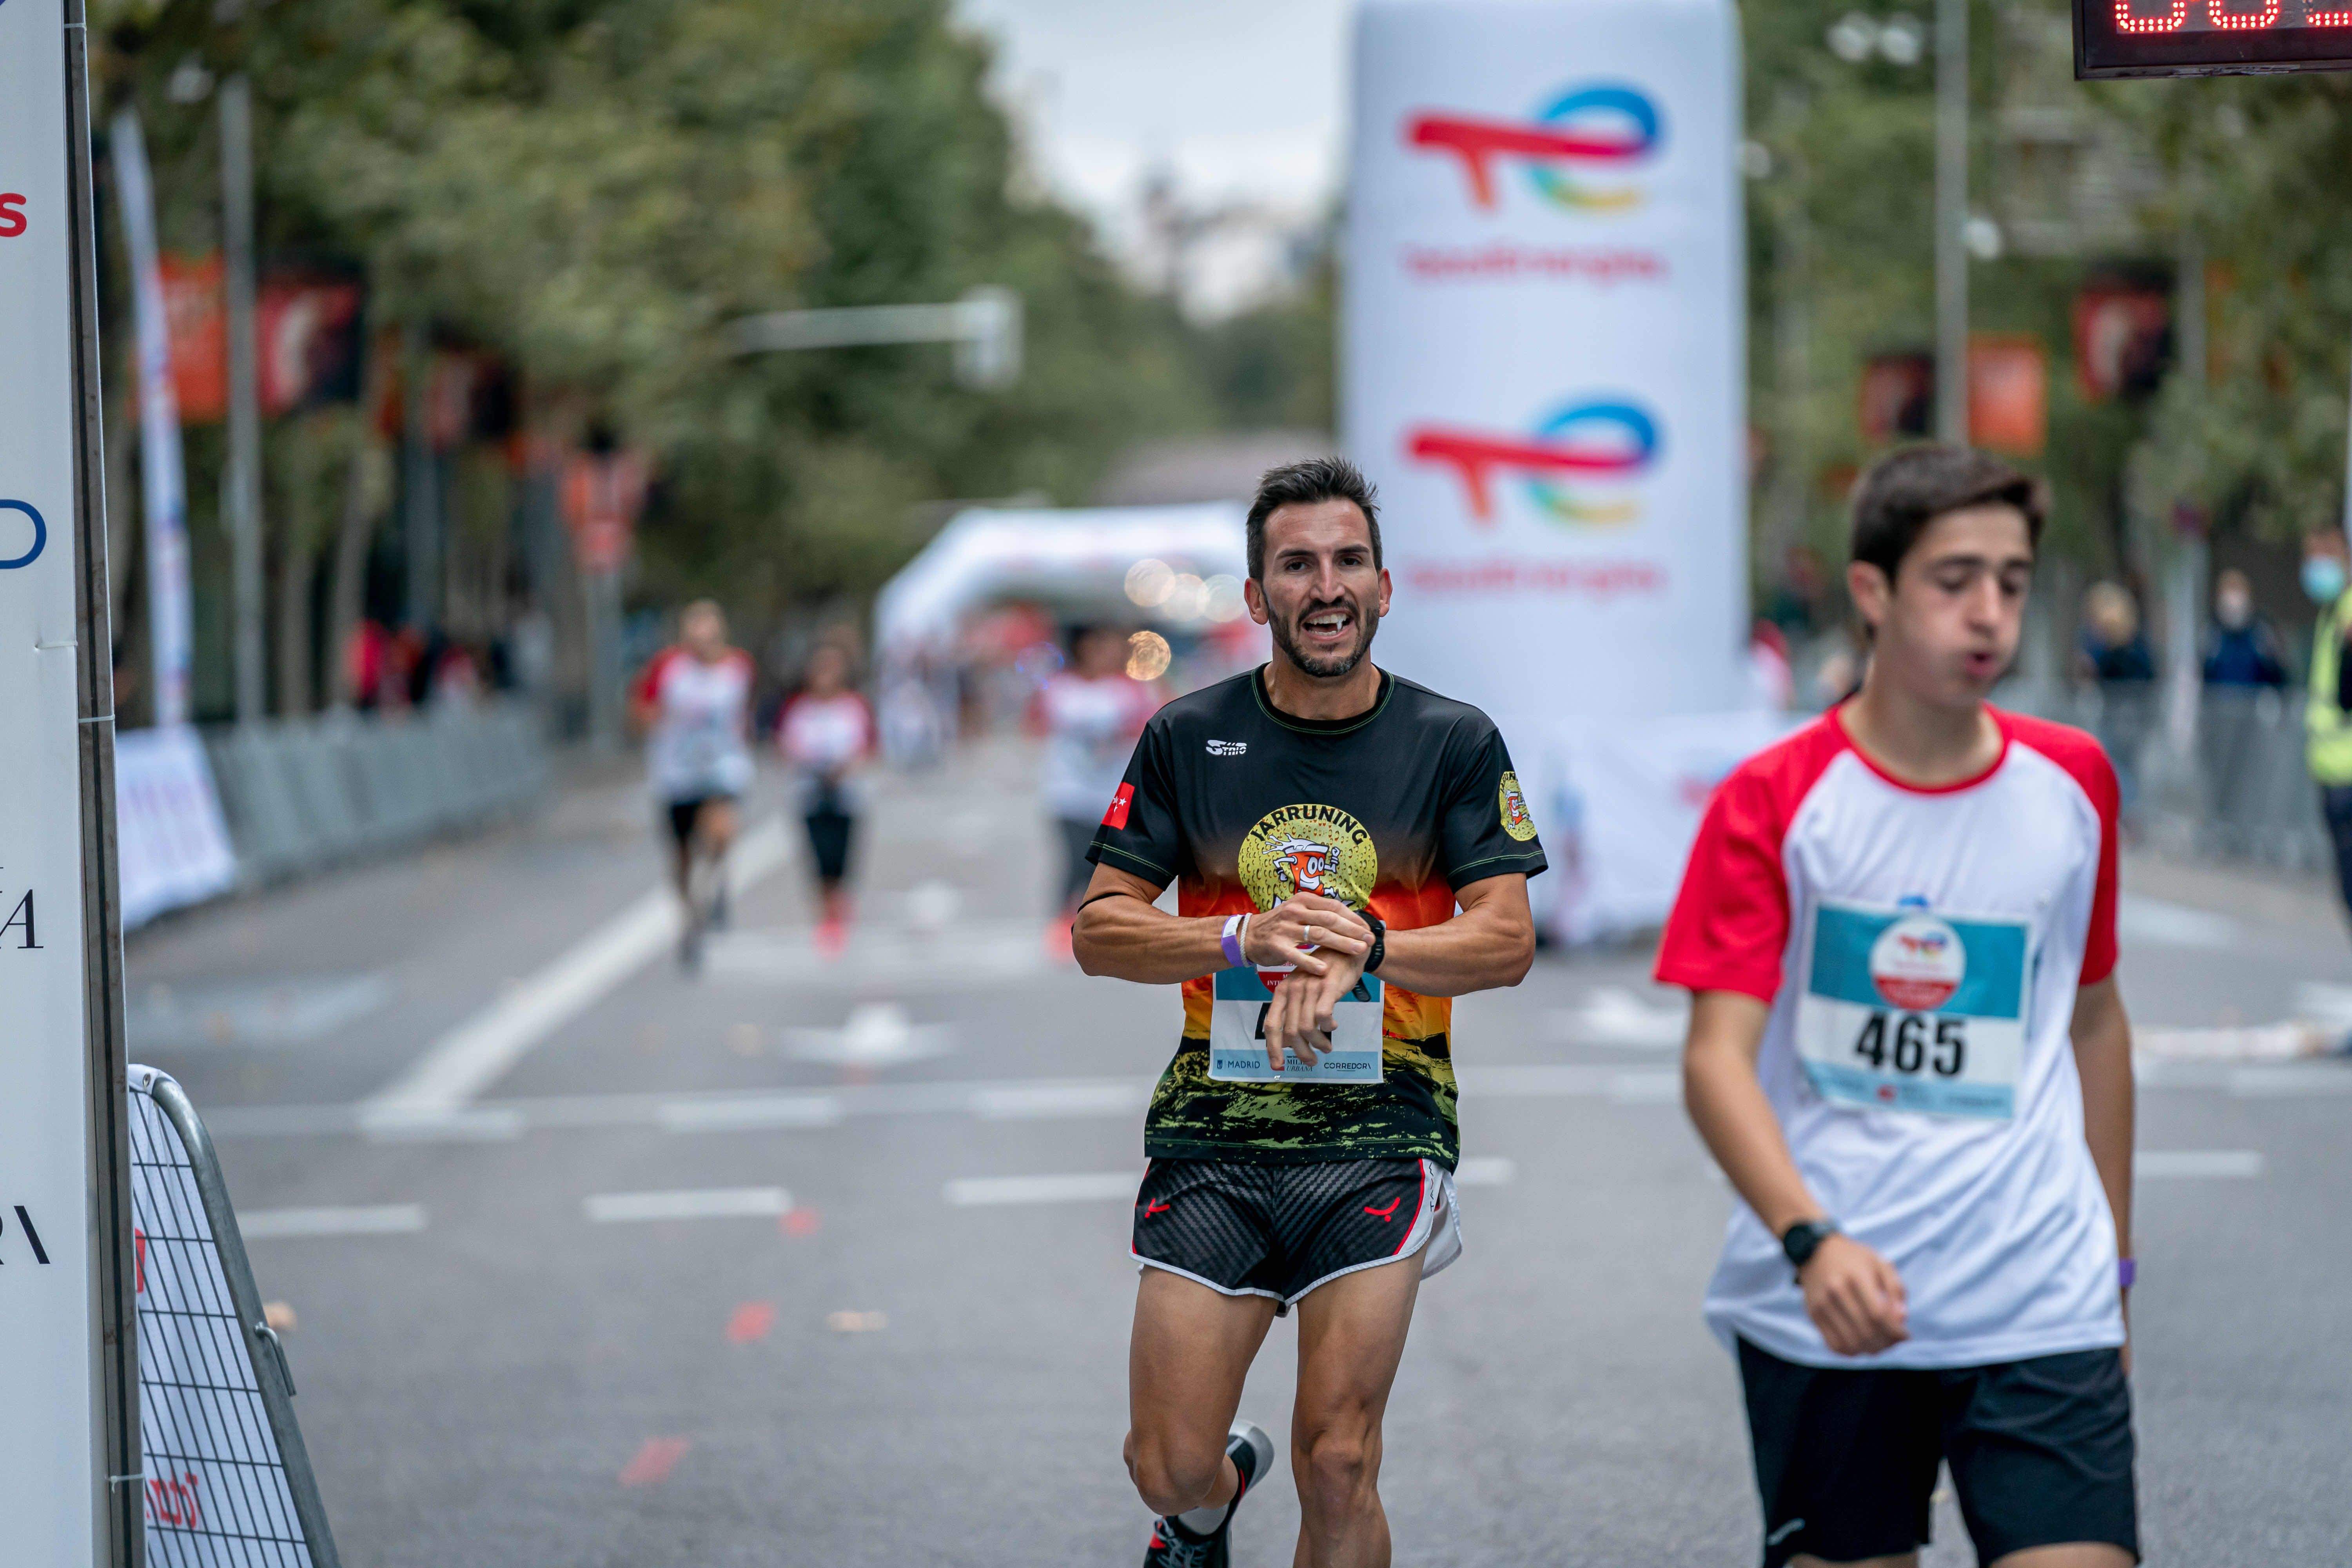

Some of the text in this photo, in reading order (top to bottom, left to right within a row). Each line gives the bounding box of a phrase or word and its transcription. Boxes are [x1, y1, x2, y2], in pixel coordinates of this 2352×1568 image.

[1250, 805, 1368, 846] JARRUNING
[1228, 1060, 1261, 1069] MADRID
[1857, 1013, 1965, 1075] 465
